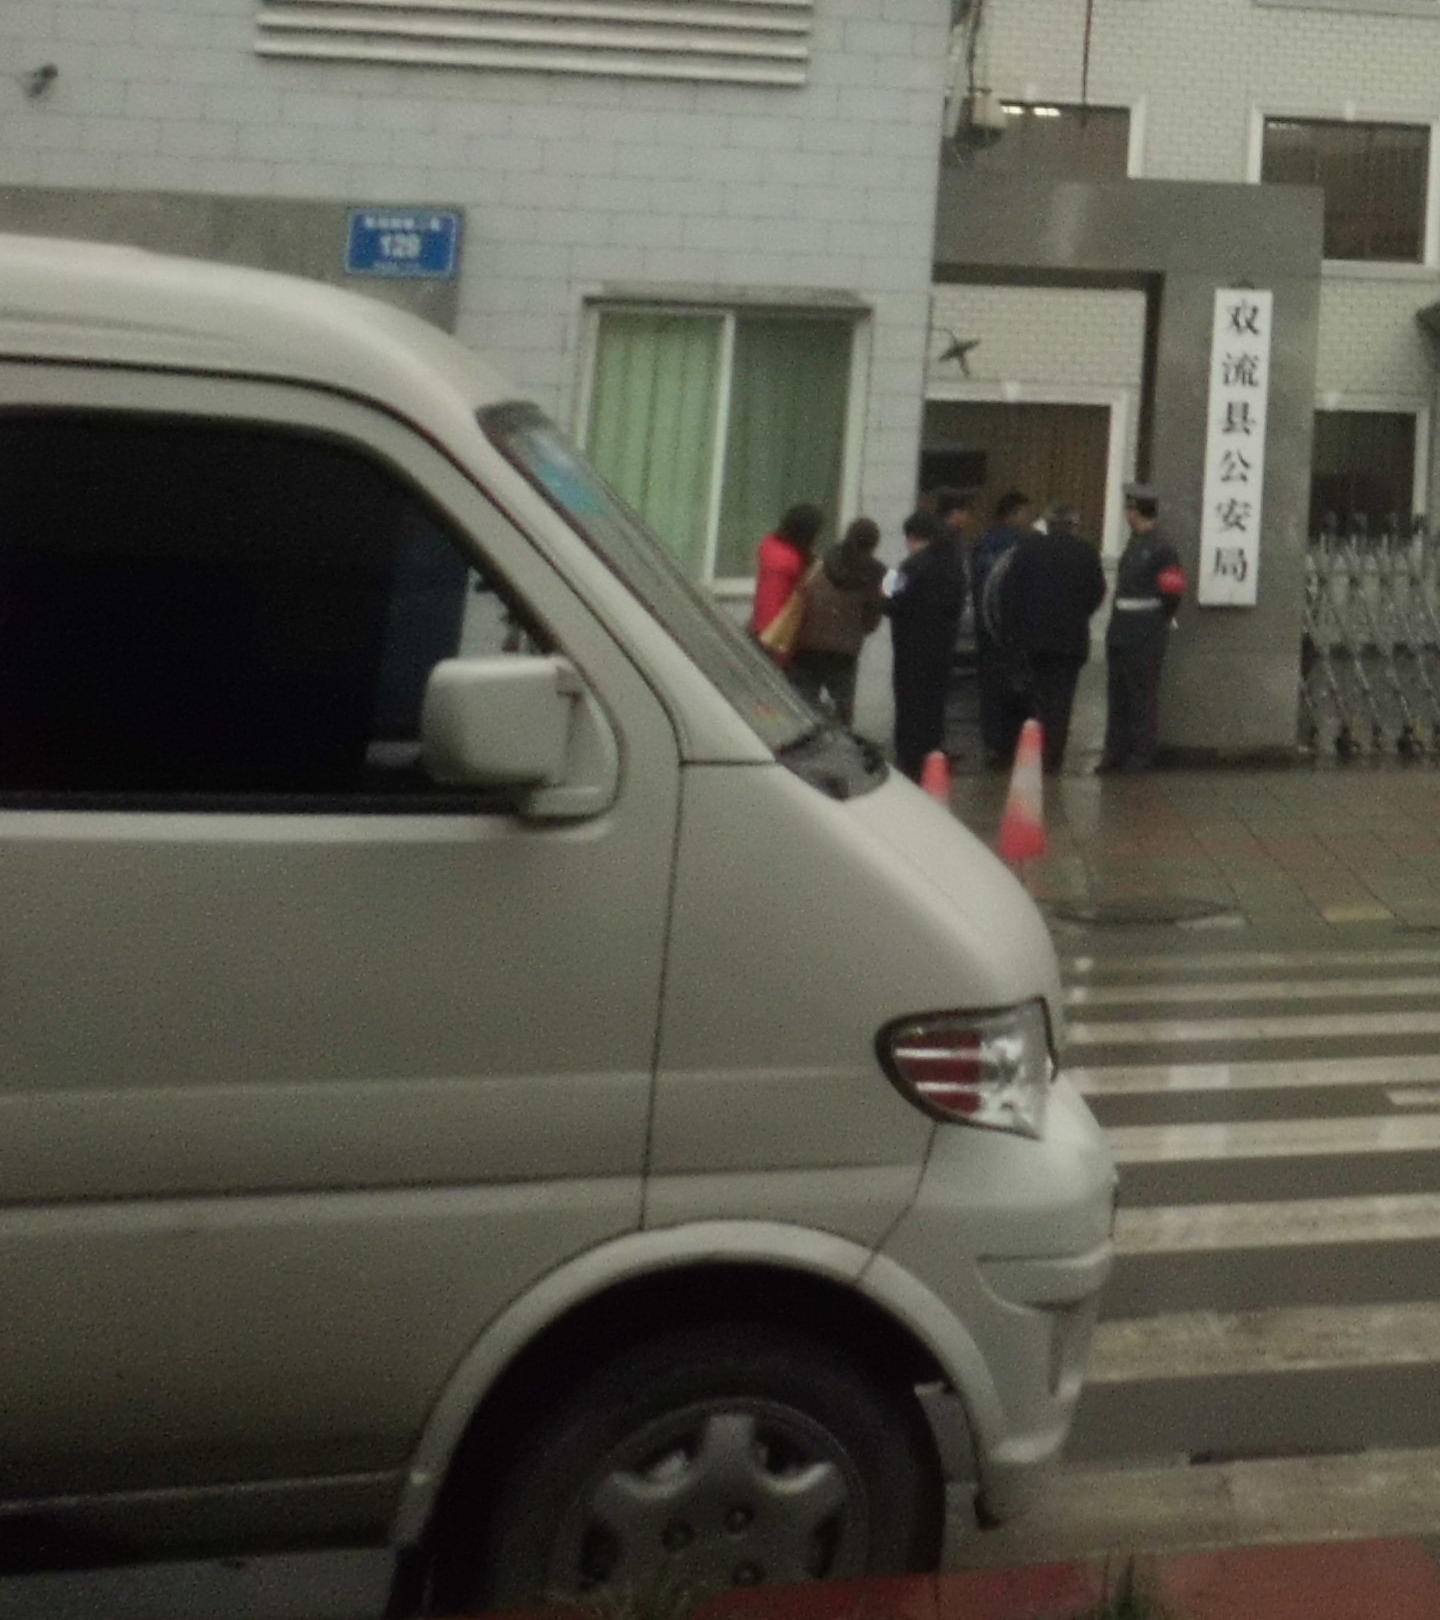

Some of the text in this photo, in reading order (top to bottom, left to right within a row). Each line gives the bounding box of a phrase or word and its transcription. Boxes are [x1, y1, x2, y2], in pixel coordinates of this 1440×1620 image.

[1212, 299, 1260, 583] 双流县公安局
